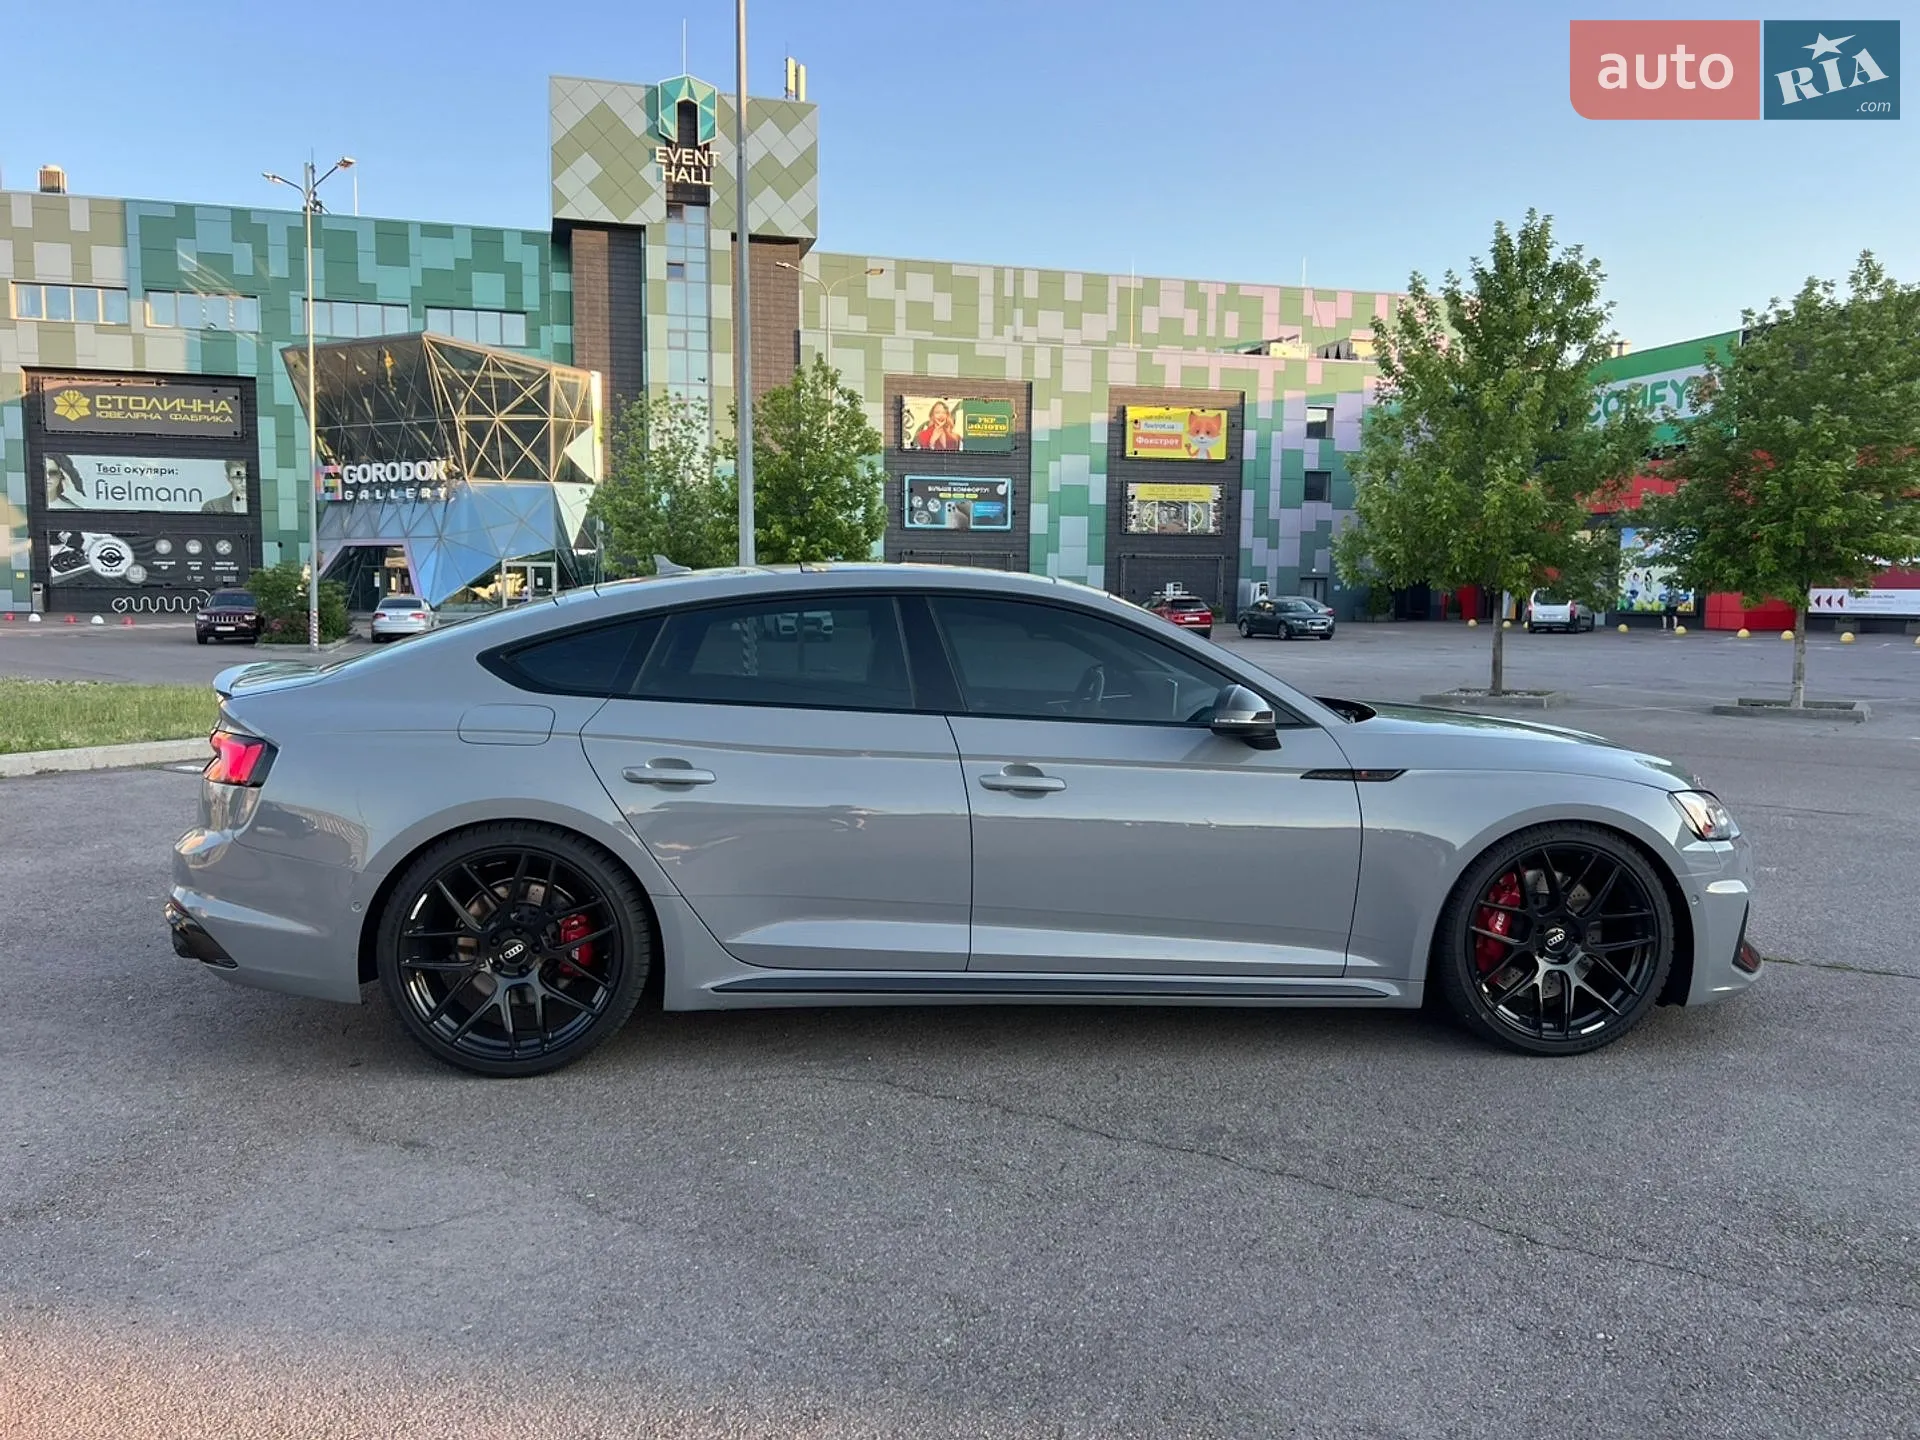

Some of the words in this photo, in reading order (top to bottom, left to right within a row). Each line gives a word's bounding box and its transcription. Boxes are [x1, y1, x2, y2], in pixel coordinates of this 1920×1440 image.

[655, 146, 721, 167] EVENT
[662, 165, 714, 185] HALL
[95, 394, 233, 414] СТОЛИЧНА
[1587, 377, 1693, 423] COFY
[96, 410, 162, 421] ЮВЕЛІРНА
[169, 412, 233, 424] ФАБРИКА
[96, 463, 122, 474] Твої
[124, 466, 179, 477] окуляри:
[342, 459, 448, 484] GORODOK
[95, 478, 203, 503] fielmann
[344, 487, 448, 500] GALLERY
